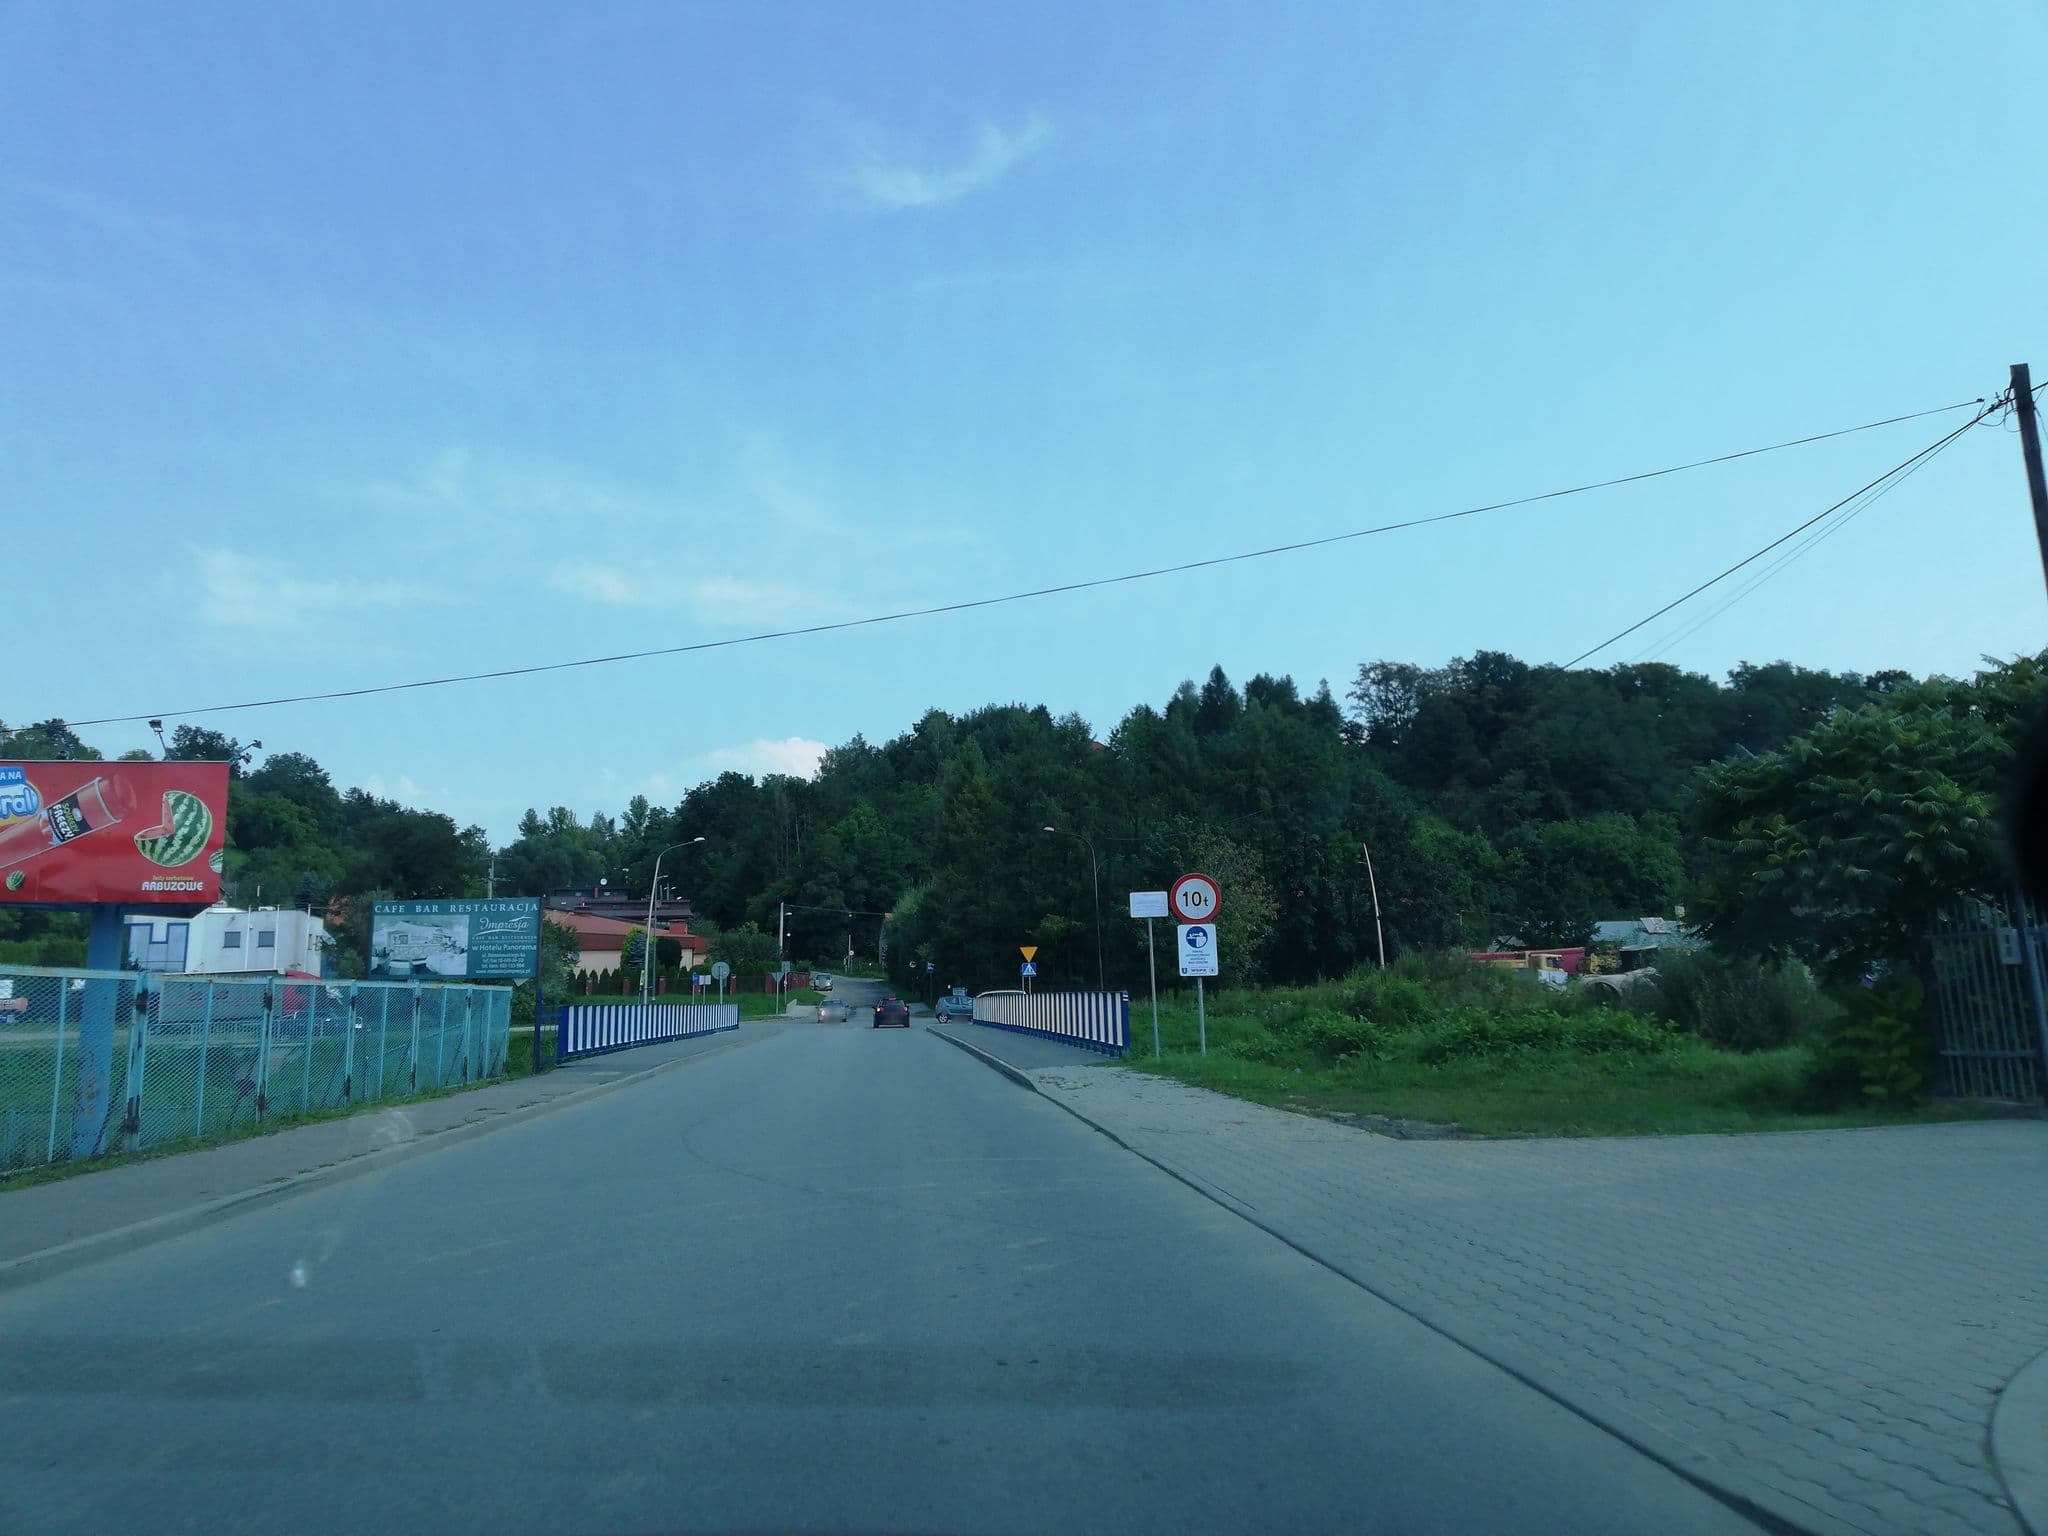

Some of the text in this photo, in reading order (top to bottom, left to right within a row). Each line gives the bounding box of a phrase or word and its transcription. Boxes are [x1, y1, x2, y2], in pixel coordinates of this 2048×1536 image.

[8, 771, 22, 780] NA
[0, 787, 33, 816] ral
[52, 803, 75, 838] FREEZY
[142, 881, 204, 891] ARBUZOWE
[374, 903, 538, 913] CAFE BAR RESTAURACJA
[480, 917, 530, 931] Impresja
